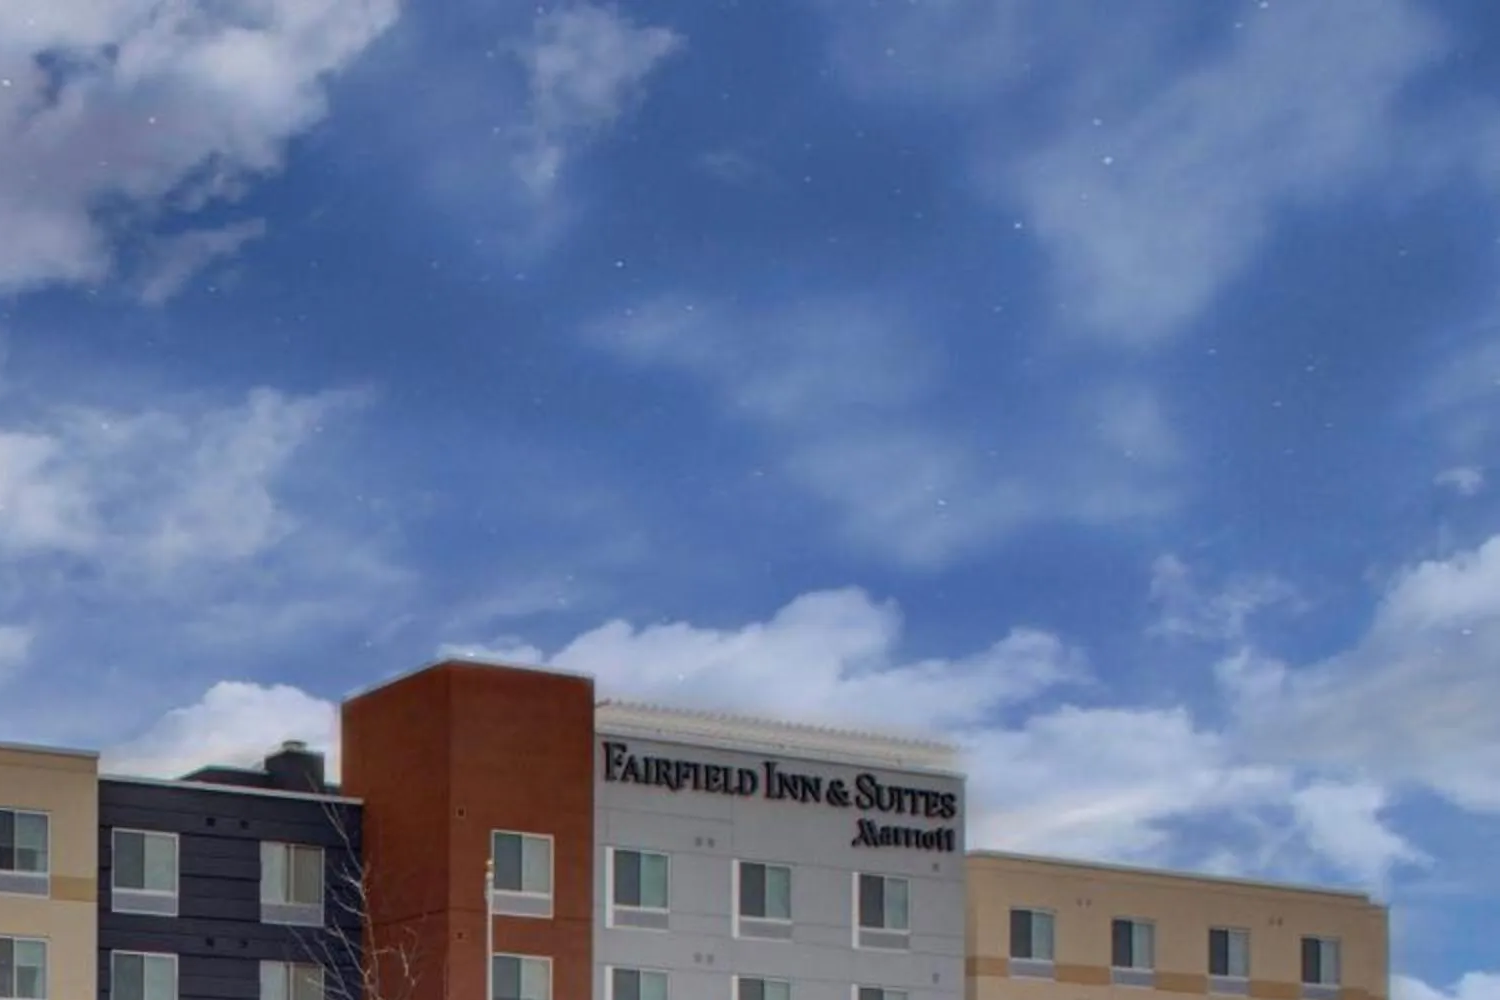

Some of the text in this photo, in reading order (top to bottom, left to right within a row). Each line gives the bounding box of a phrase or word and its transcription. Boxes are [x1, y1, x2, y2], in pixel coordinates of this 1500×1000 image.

[603, 742, 956, 818] FAIRFIELD INN & SUITES
[852, 818, 954, 852] Marriott
